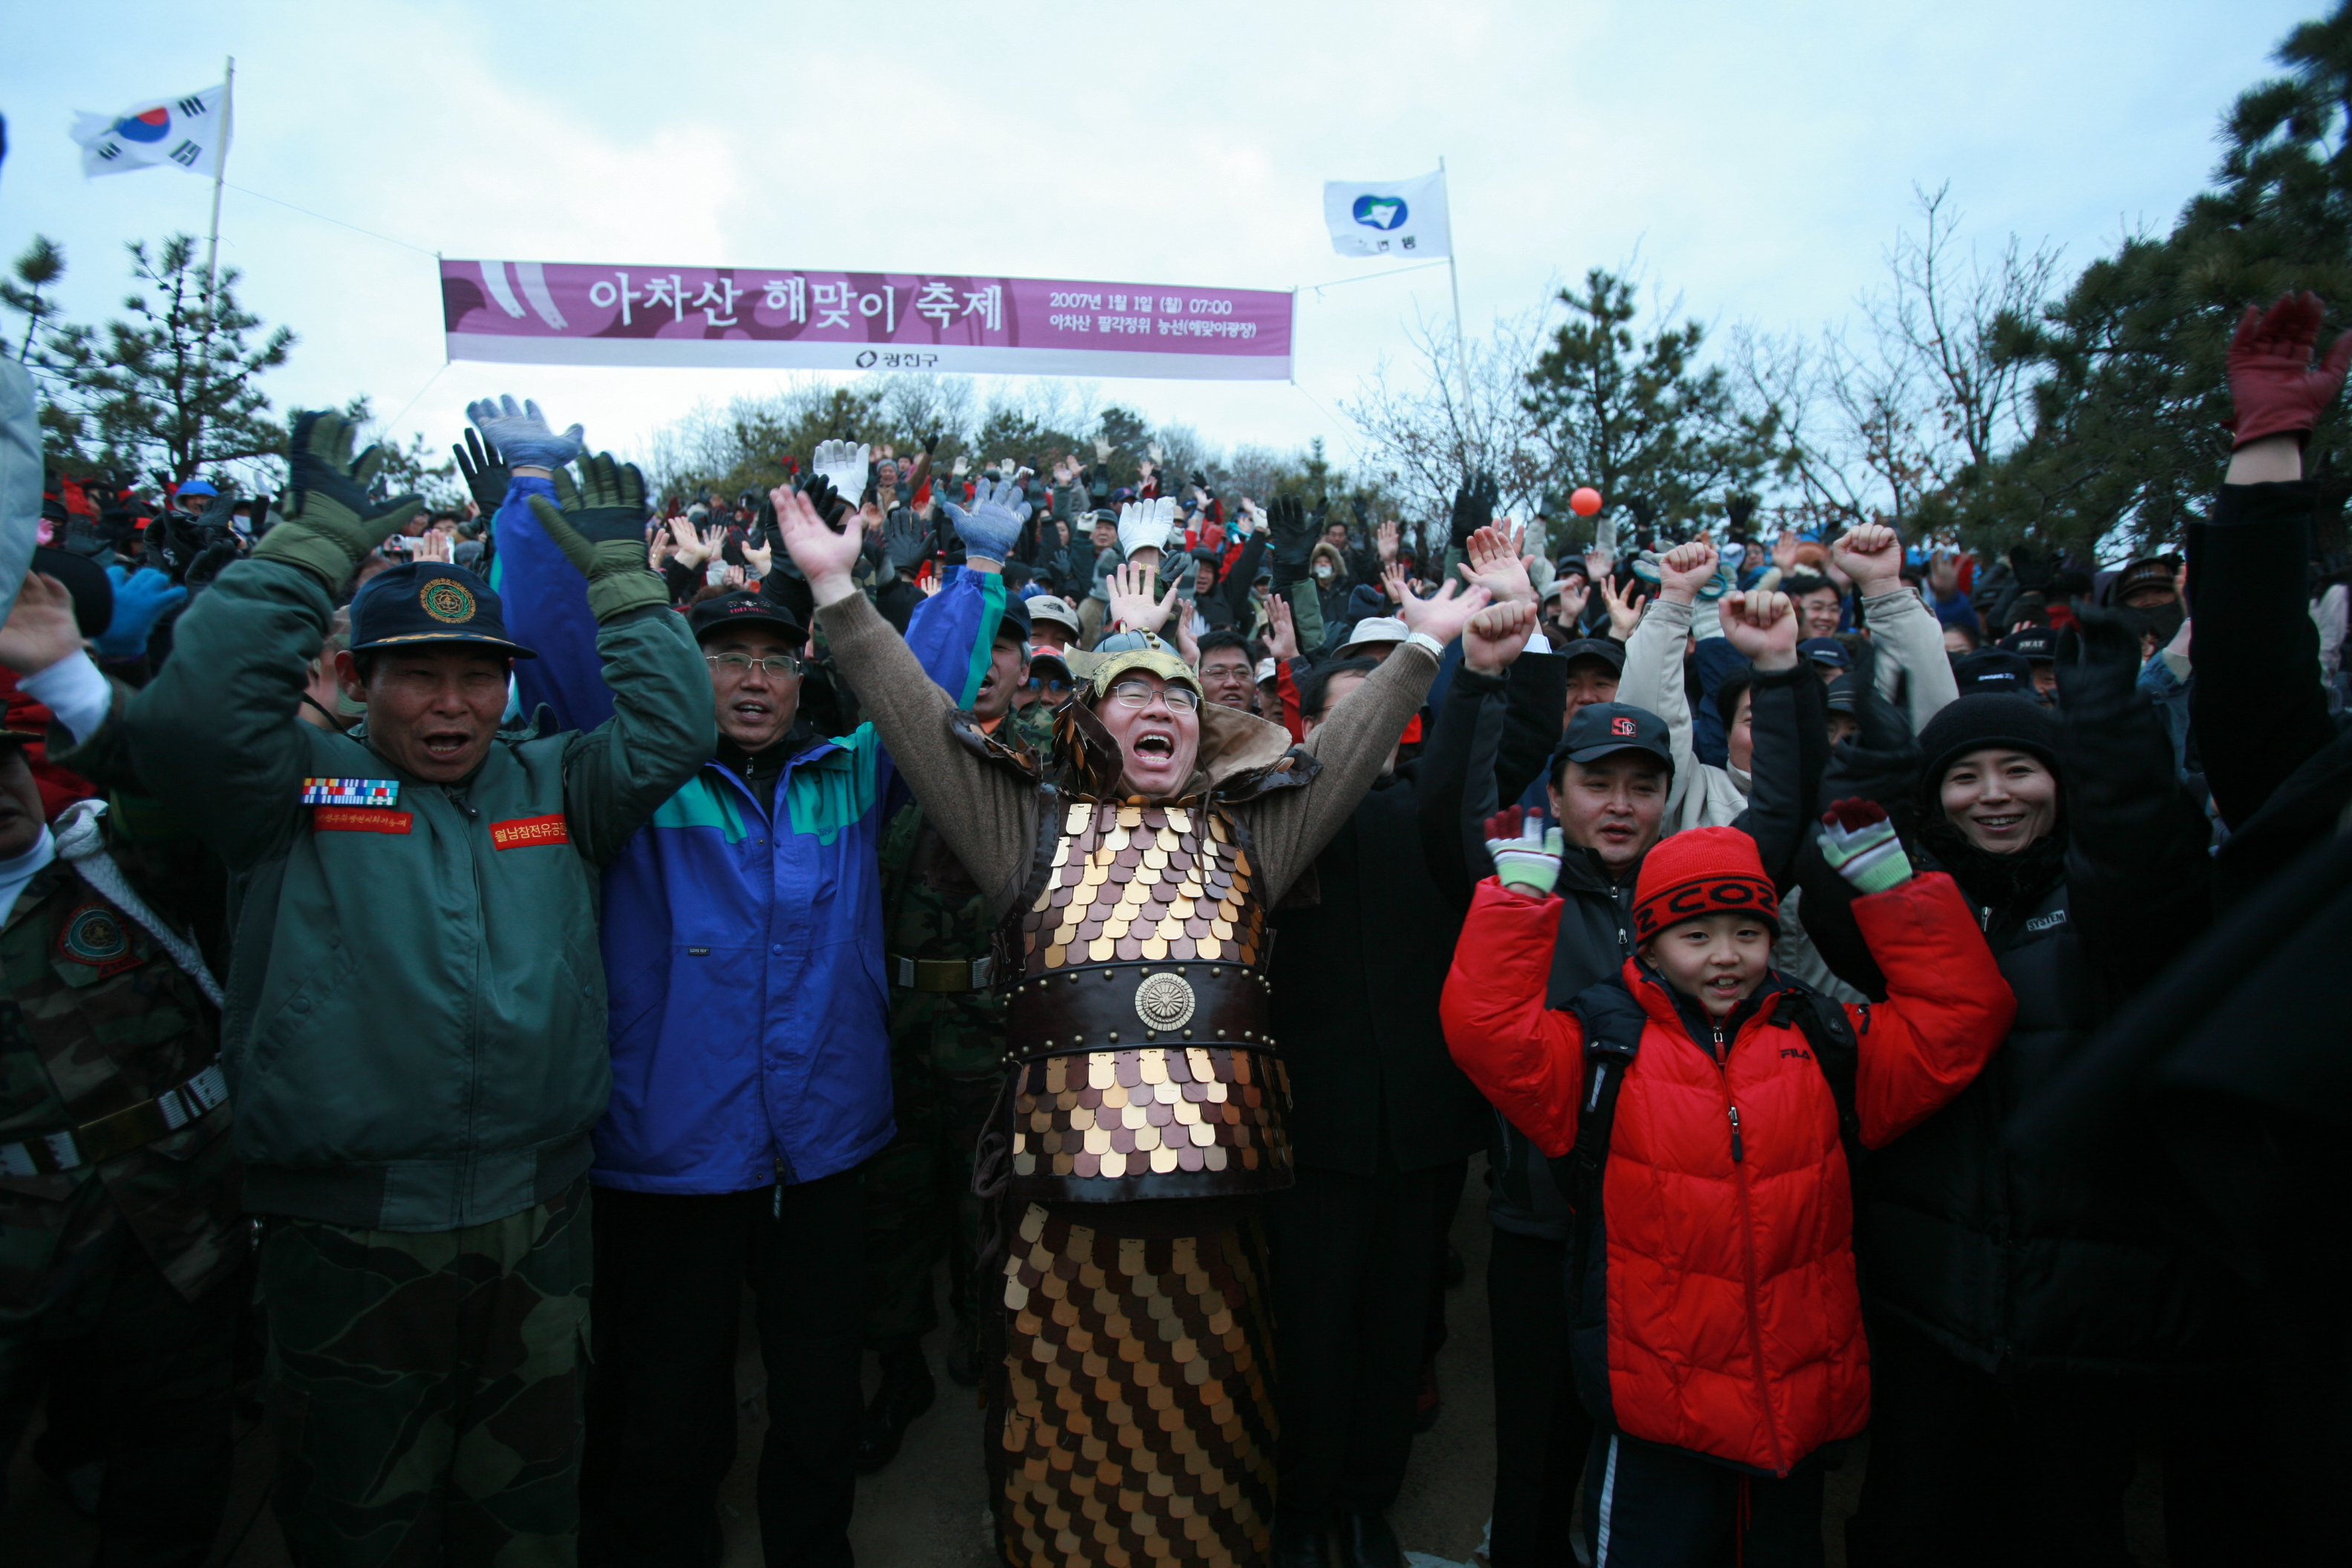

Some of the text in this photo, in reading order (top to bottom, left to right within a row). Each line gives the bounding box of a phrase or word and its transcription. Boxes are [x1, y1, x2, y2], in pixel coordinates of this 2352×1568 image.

[589, 272, 1002, 333] 아차산 해맞이 축제
[1050, 292, 1232, 315] 2007년 1월 1일 (월) 07:00
[1049, 314, 1257, 339] 아차산 팔각정위 능선(해맞이광장)
[883, 353, 938, 368] 광진구
[2028, 912, 2065, 930] SYSTEM
[1780, 1048, 1810, 1060] FILA
